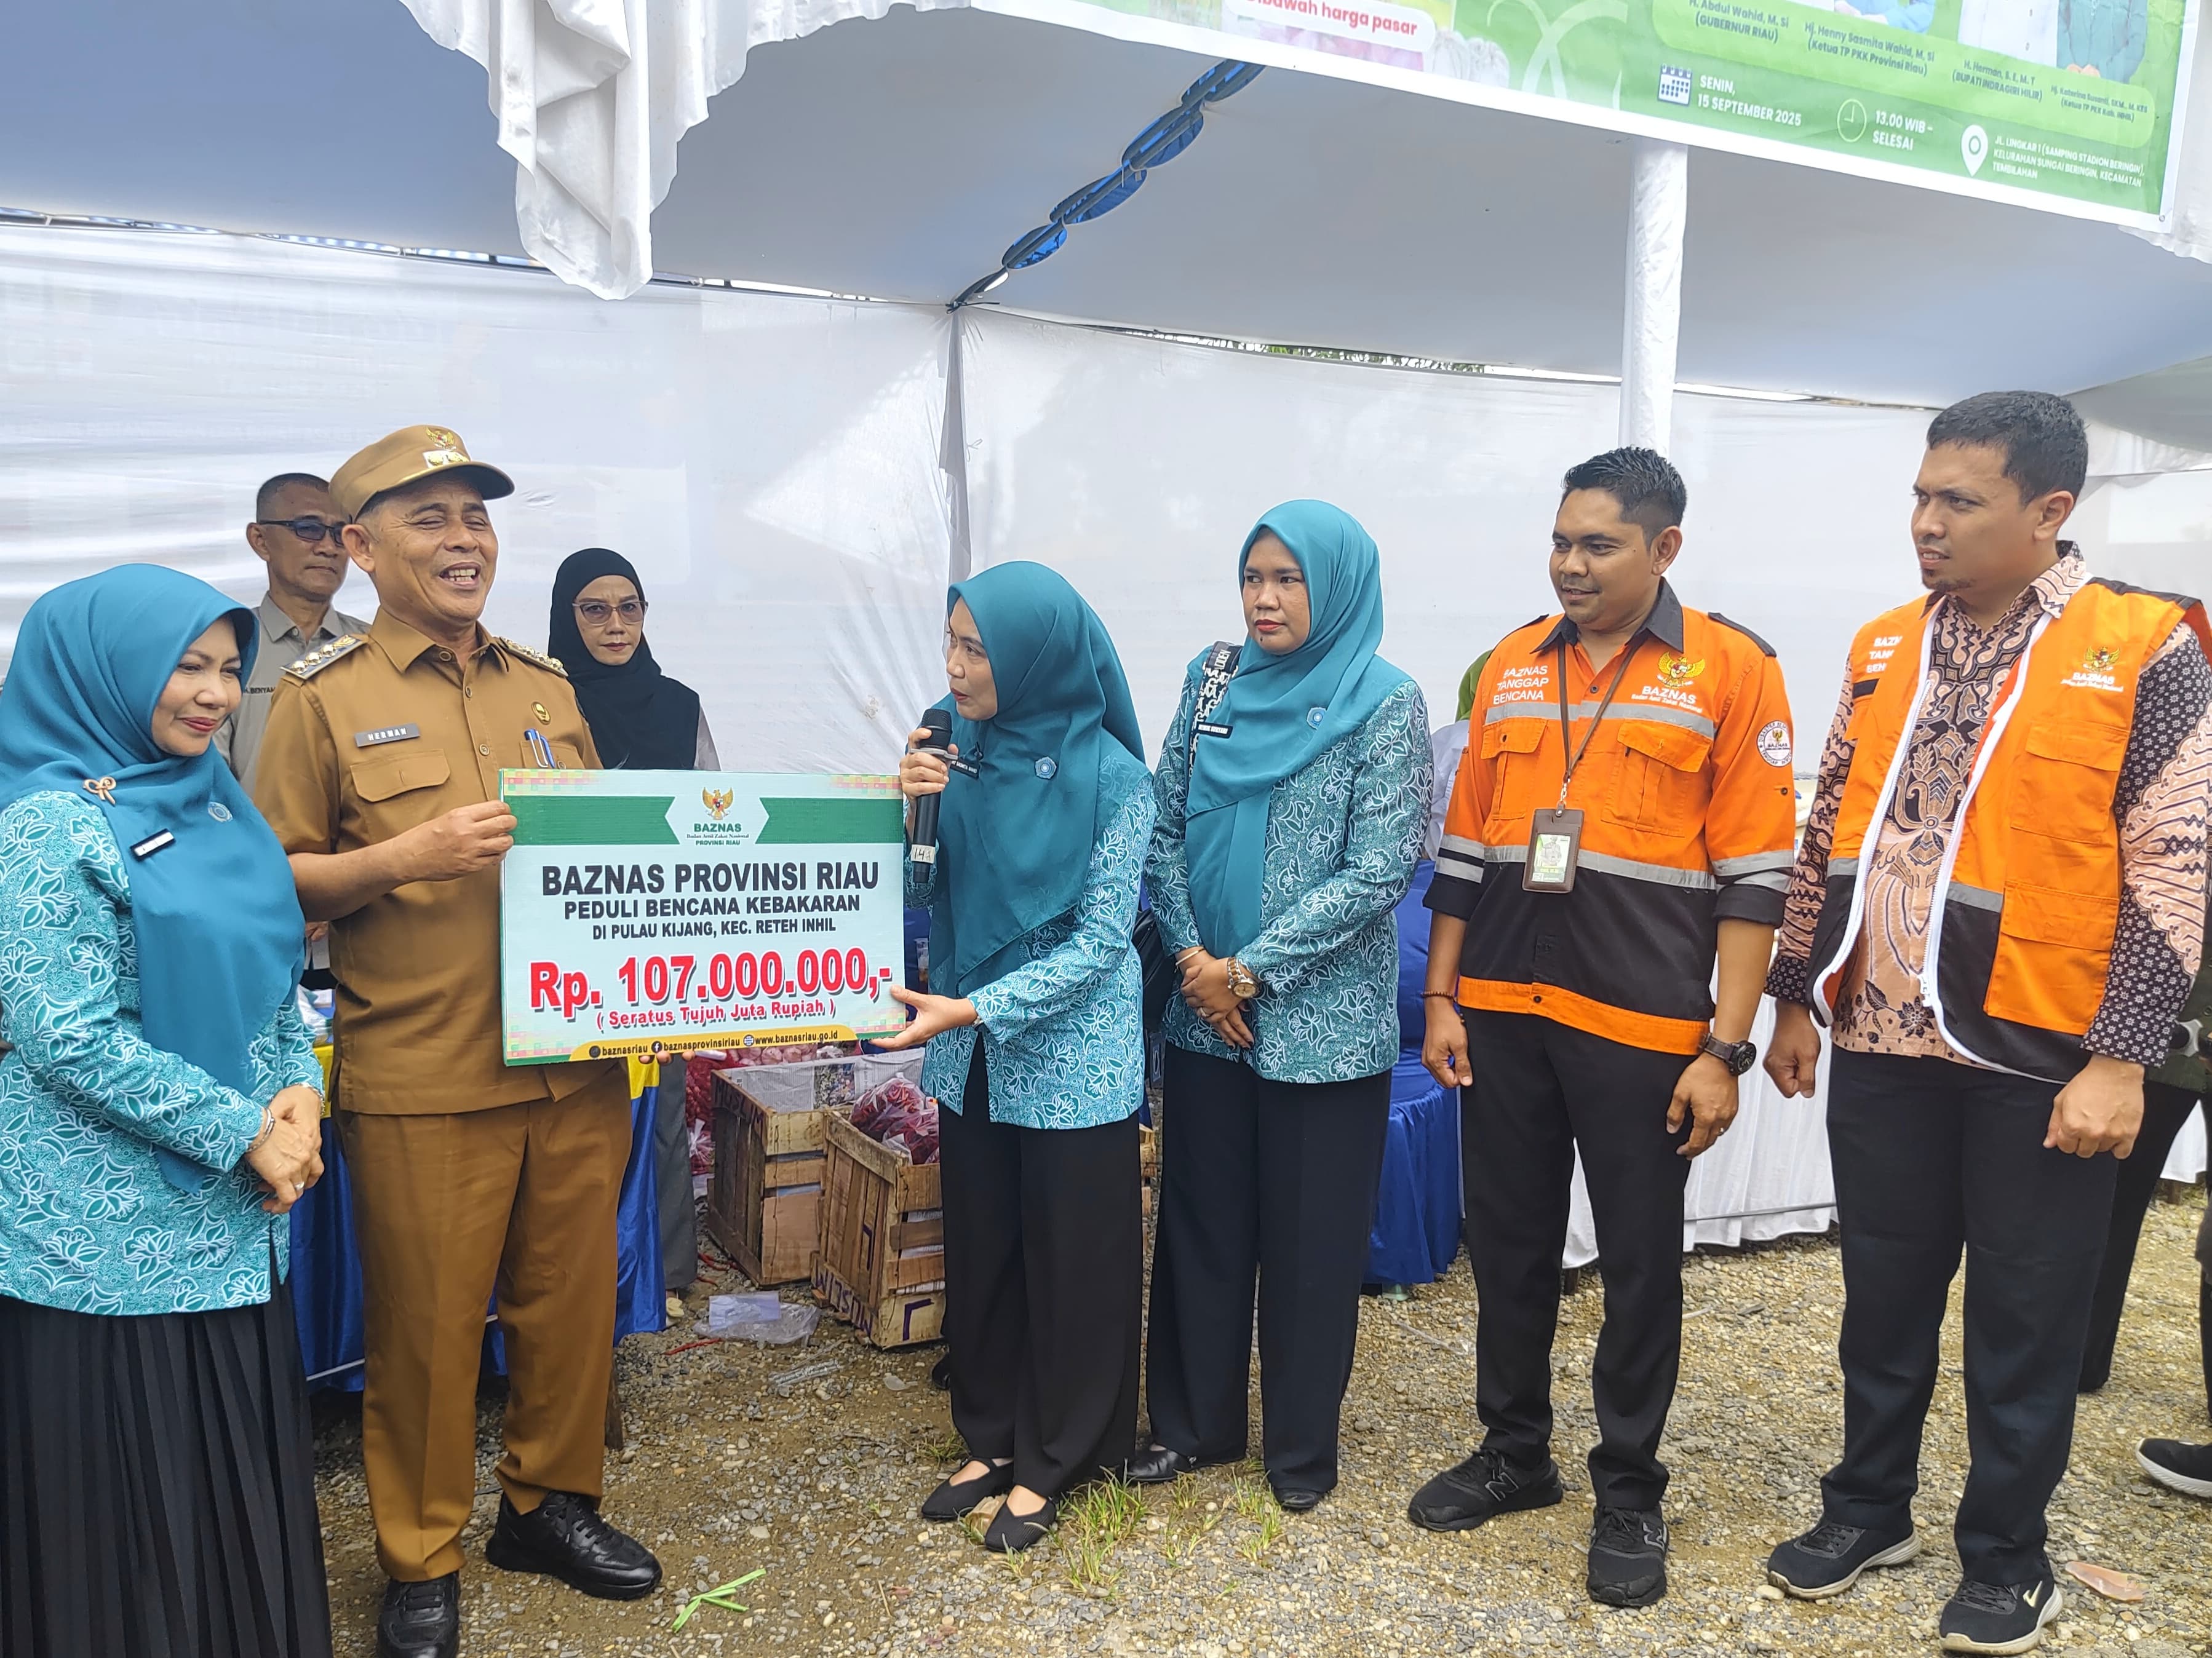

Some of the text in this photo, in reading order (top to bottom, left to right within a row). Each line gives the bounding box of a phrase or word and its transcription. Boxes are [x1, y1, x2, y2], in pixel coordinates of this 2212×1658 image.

[1322, 4, 1369, 28] harga
[1372, 15, 1417, 36] pasar
[1701, 0, 1730, 14] Abdul
[1732, 6, 1765, 24] Wahid,
[1767, 14, 1778, 25] M.
[1696, 11, 1778, 44] (GUBERNUR RIAU)
[1808, 34, 1927, 77] (Ketua TP PKK Provinsi Riau)
[1818, 25, 1847, 43] Henny
[1848, 33, 1884, 50] Sasmita
[1885, 41, 1914, 58] Wahid,
[1916, 49, 1925, 60] M.
[1927, 51, 1935, 62] Si
[1700, 74, 1735, 96] SENIN,
[1952, 69, 2042, 103] (BUPATI INDRAGIRI HILIR)
[1698, 93, 1802, 126] 15 SEPTEMBER 2025
[1876, 109, 1903, 129] 13.00
[1904, 117, 1926, 133] WIB
[1872, 130, 1914, 151] SELESAI
[1995, 135, 2005, 146] JL.
[2006, 137, 2037, 153] LINGKAR
[2079, 153, 2109, 168] STADION
[1993, 148, 2037, 166] KELURAHAN
[2037, 157, 2064, 172] SUNGAI
[2099, 170, 2142, 187] KECAMATAN
[1993, 161, 2038, 180] TEMBILAHAN
[1493, 689, 1544, 705] BENCANA
[1497, 677, 1549, 692] TANGGAP
[1642, 685, 1697, 704] BAZNAS
[368, 727, 407, 741] HERMAN
[694, 823, 742, 833] BAZNAS
[541, 862, 879, 896] BAZNAS PROVINSI RIAU
[565, 895, 860, 919] PEDULI BENCANA KEBAKARAN
[593, 918, 836, 940] DI PULAU KIJANG, KEC. RETEH INHIL
[530, 947, 893, 1021] Rp. 107.000.000,-
[608, 1010, 675, 1028] Seratus
[680, 1006, 727, 1025] Tujuh
[730, 1003, 767, 1020] Juta
[771, 999, 826, 1019] Rupiah
[602, 1029, 838, 1057] baznasriau baznasprovinsiriau www.baznasriau.go.id
